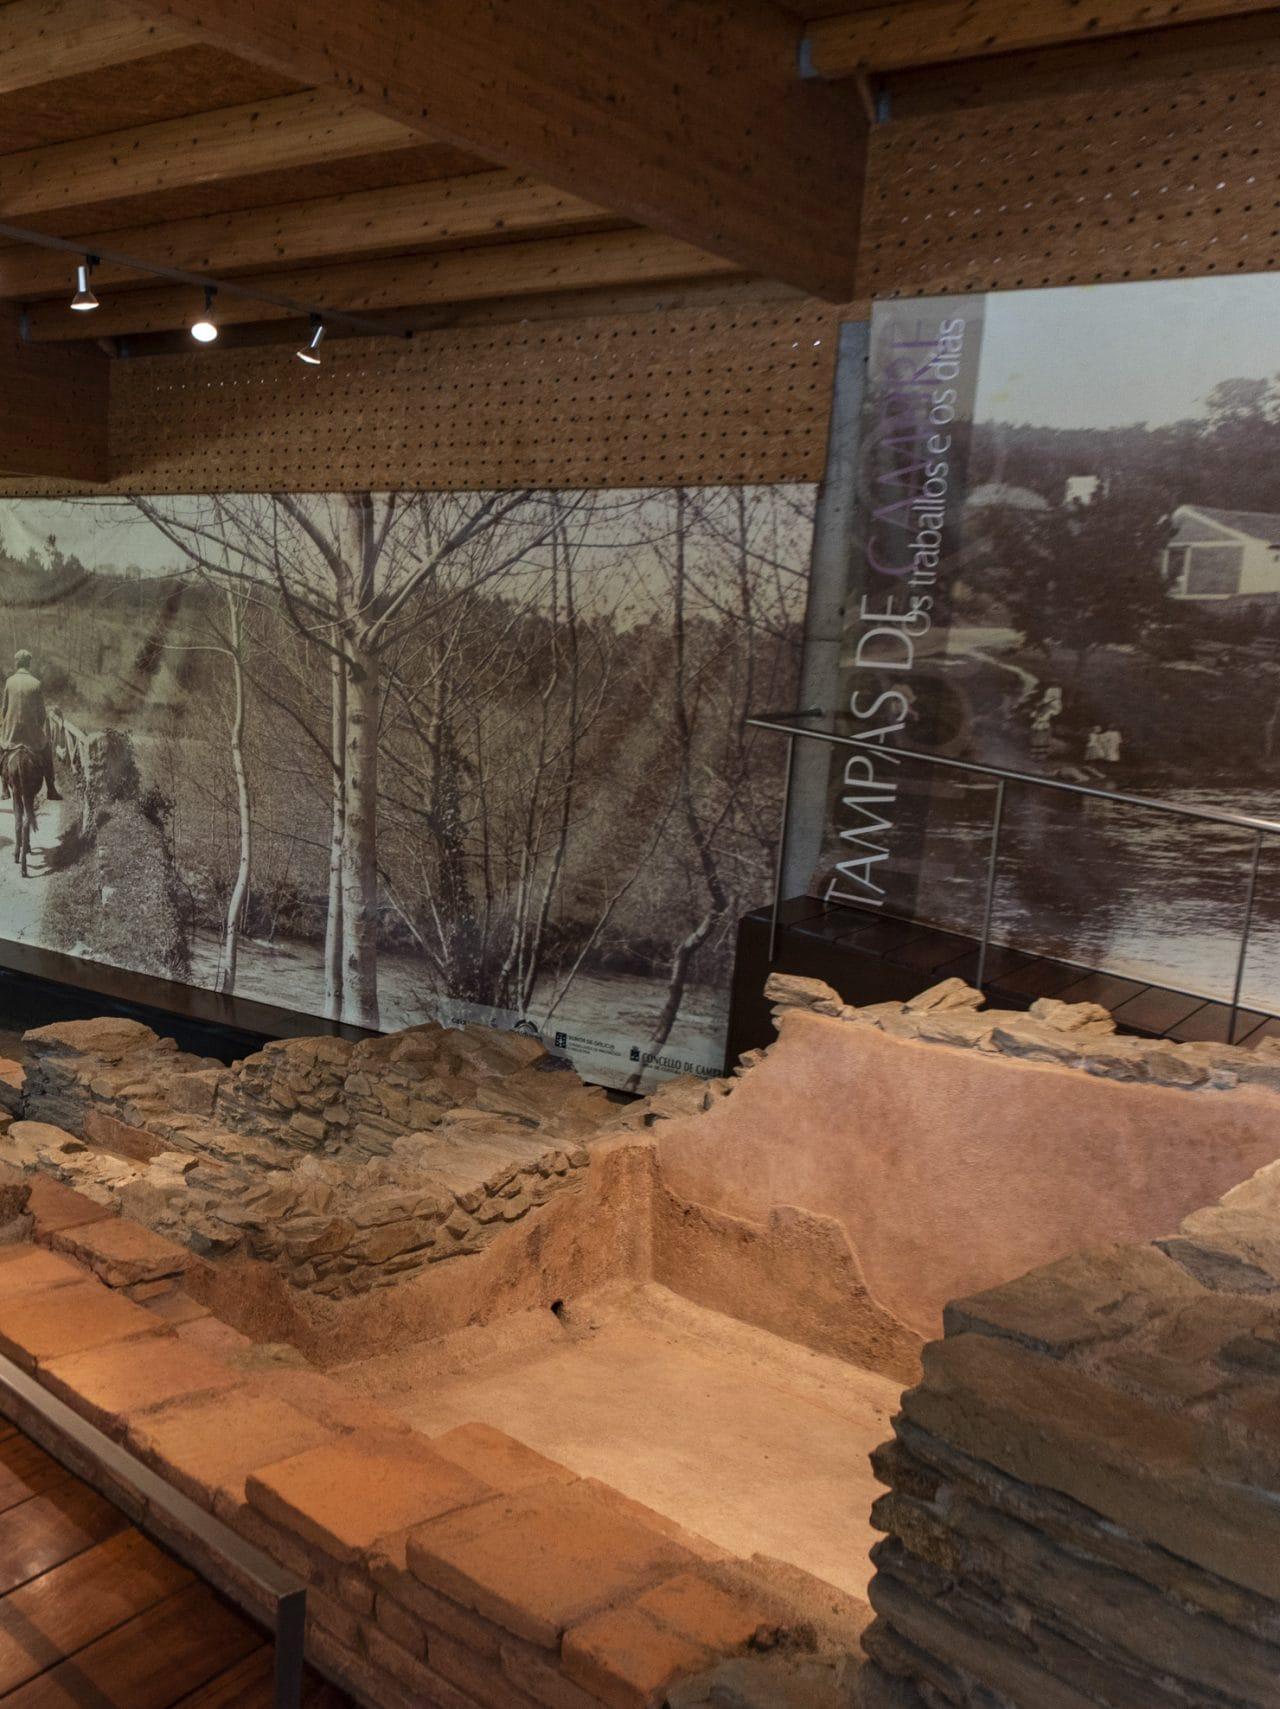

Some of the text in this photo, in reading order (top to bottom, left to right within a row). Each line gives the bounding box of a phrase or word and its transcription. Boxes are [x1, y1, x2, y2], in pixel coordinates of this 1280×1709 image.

[929, 388, 957, 426] os
[927, 433, 952, 455] e
[908, 460, 949, 586] traballos
[855, 594, 917, 669] DE
[901, 594, 933, 637] Os
[642, 1053, 682, 1070] CONCELLO
[684, 1061, 695, 1074] DE
